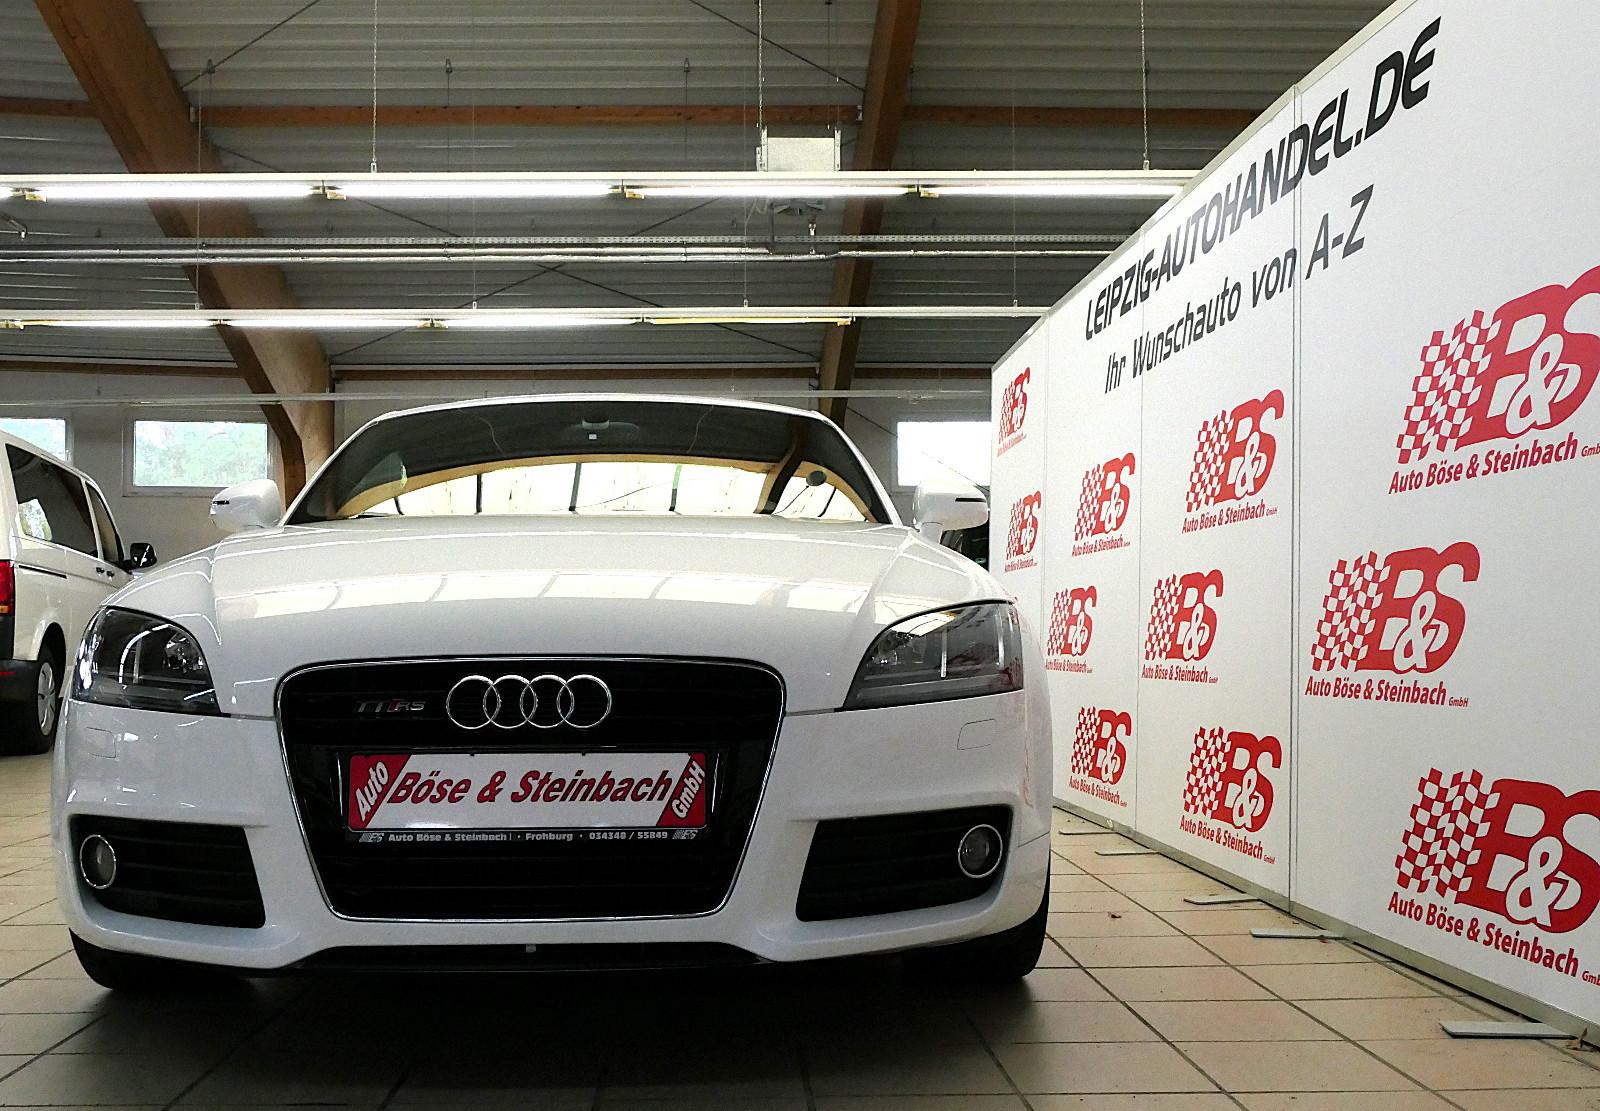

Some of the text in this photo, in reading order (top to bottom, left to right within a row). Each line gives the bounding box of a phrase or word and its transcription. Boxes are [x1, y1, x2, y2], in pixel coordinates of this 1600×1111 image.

[1085, 16, 1442, 341] LEIPZIG-AUTOHANDEL.DE
[1104, 184, 1375, 394] Ihr Wunschauto von A-Z
[1388, 469, 1423, 494] Auto
[1425, 460, 1462, 488] Böse
[1466, 453, 1479, 479] &
[1482, 432, 1579, 475] Steinbach
[1182, 516, 1199, 534] Auto
[1200, 511, 1217, 530] Böse
[1217, 509, 1223, 525] &
[1224, 499, 1266, 525] Steinbach
[1141, 664, 1154, 679] Auto
[1154, 664, 1168, 680] Böse
[1174, 665, 1209, 684] Steinbach
[1305, 676, 1469, 708] Auto Böse & Steinbach GmbH
[354, 760, 706, 821] Auto Böse & Steinbach GmbH
[388, 833, 414, 842] Auto
[416, 832, 442, 842] Böse
[454, 832, 507, 841] Steinbach
[525, 832, 573, 842] Frohburg
[1179, 815, 1197, 835] Auto
[1197, 820, 1215, 842] Böse
[1215, 827, 1222, 845] &
[1222, 830, 1264, 860] Steinbach
[1388, 891, 1424, 922] Auto
[1426, 903, 1464, 936] Böse
[1466, 917, 1480, 943] &
[1483, 922, 1579, 977] Steinbach
